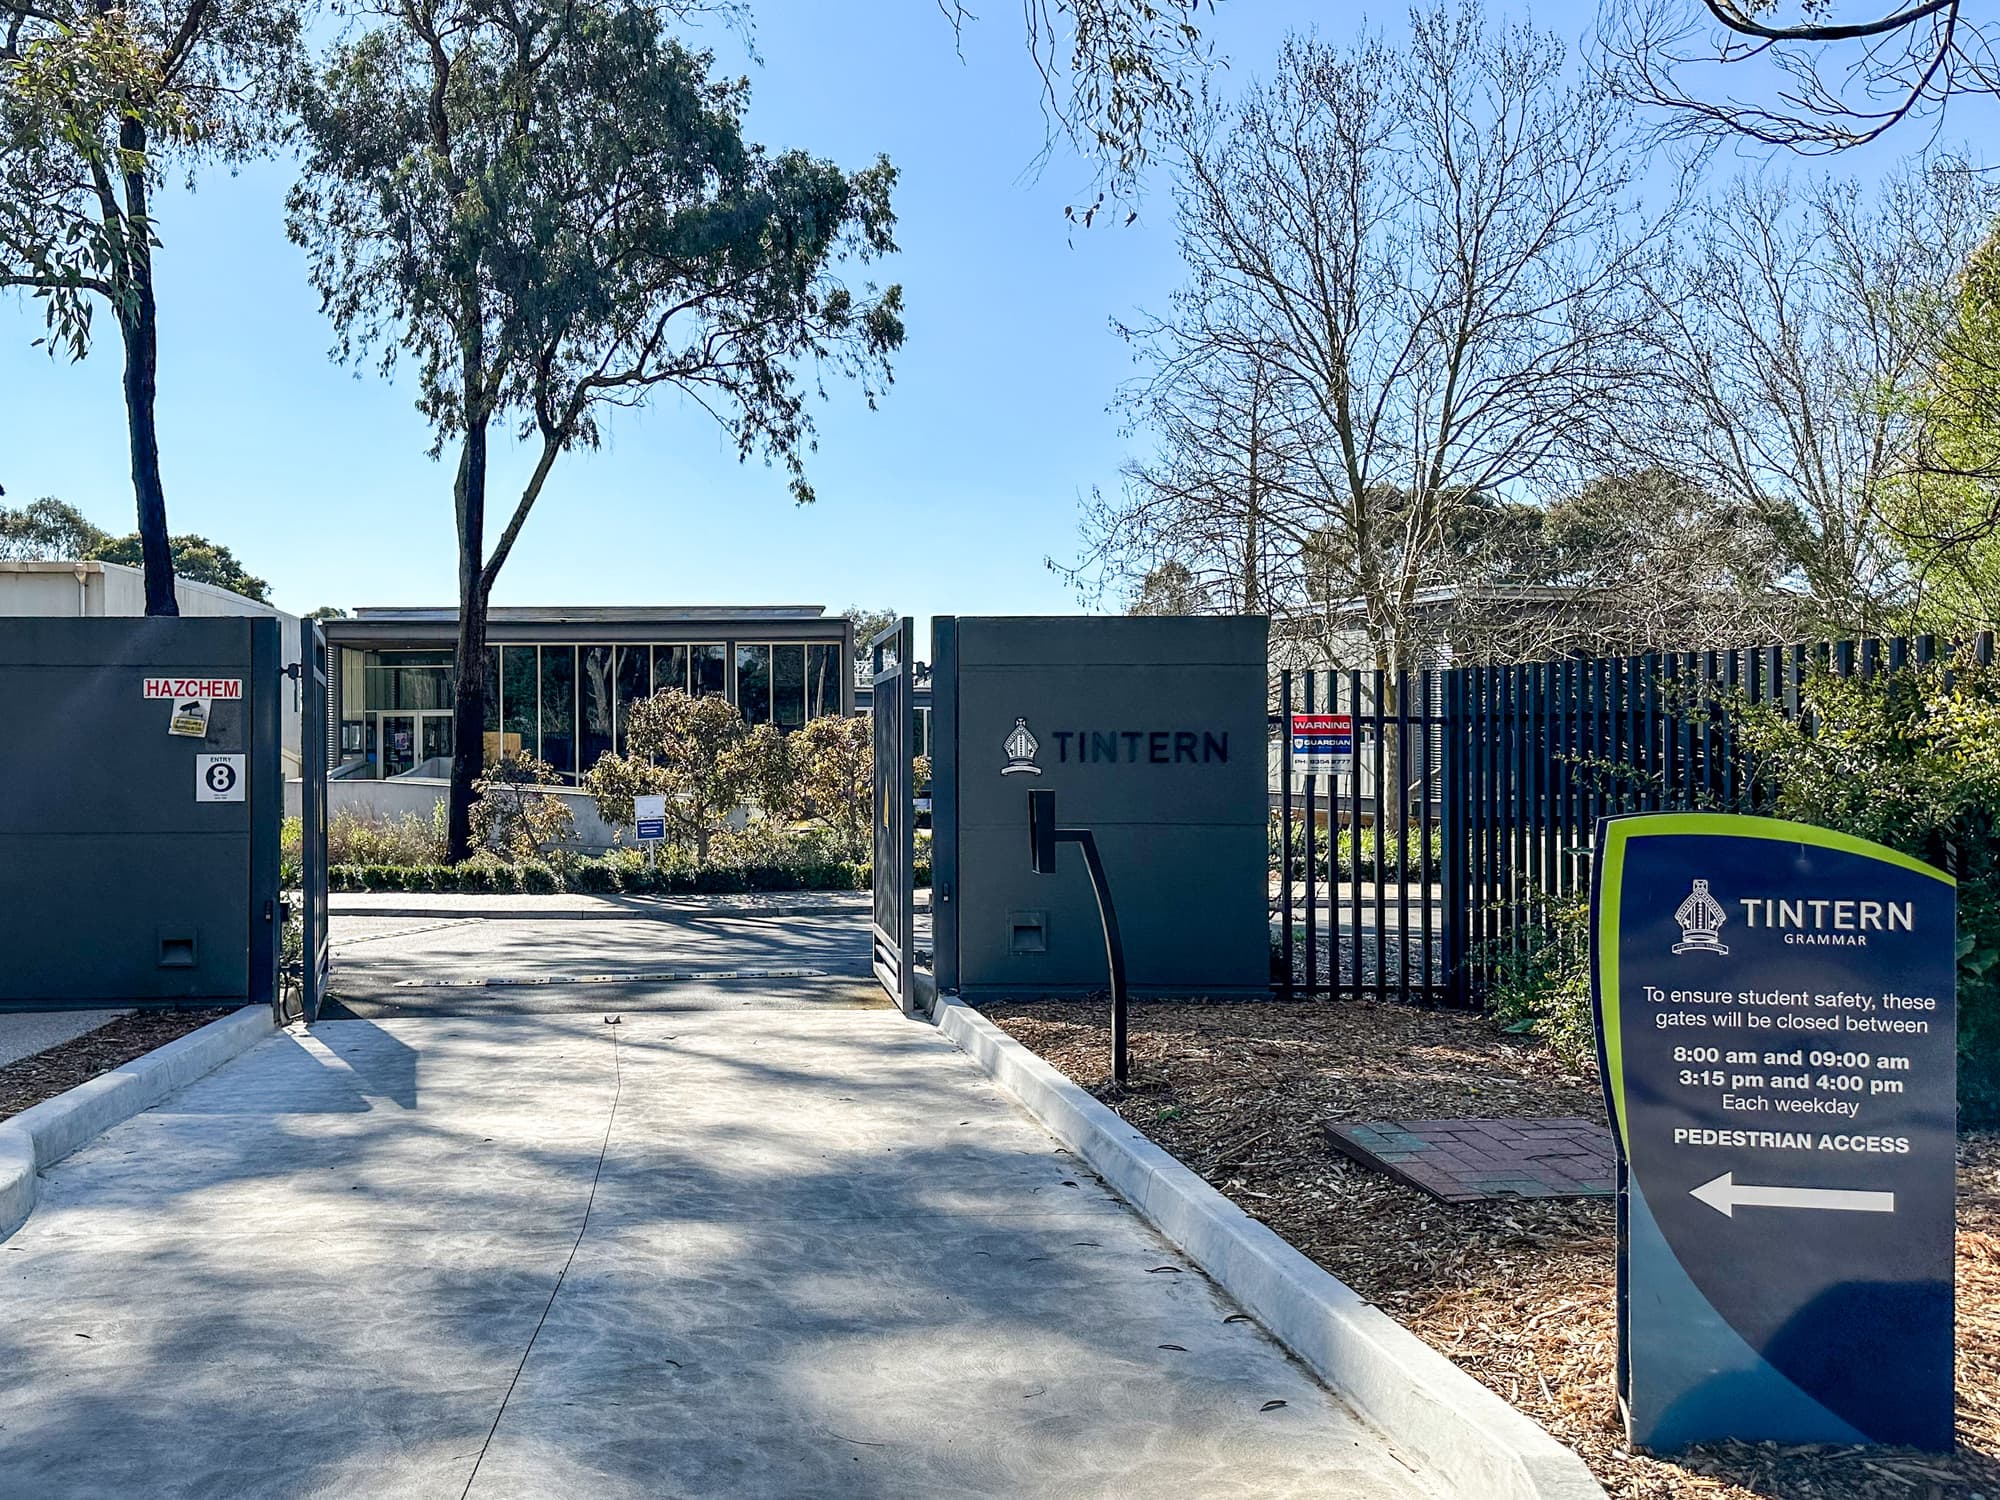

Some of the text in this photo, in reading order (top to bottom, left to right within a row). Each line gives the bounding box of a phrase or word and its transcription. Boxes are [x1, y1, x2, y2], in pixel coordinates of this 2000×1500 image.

[146, 680, 239, 697] HAZCHEM
[1052, 731, 1229, 763] TINTERN
[212, 765, 230, 790] 8
[1740, 899, 1912, 931] TINTERN
[1784, 933, 1867, 946] GRAMMAR
[1642, 986, 1936, 1012] To ensure student safety, these
[1655, 1011, 1929, 1034] gates will be closed between
[1673, 1046, 1910, 1070] 8:00 am and 09:00 am
[1679, 1069, 1904, 1096] 3:15 pm and 4:00 pm
[1722, 1093, 1860, 1119] Each weekday
[1674, 1128, 1910, 1154] PEDESTRIAN ACCESS
